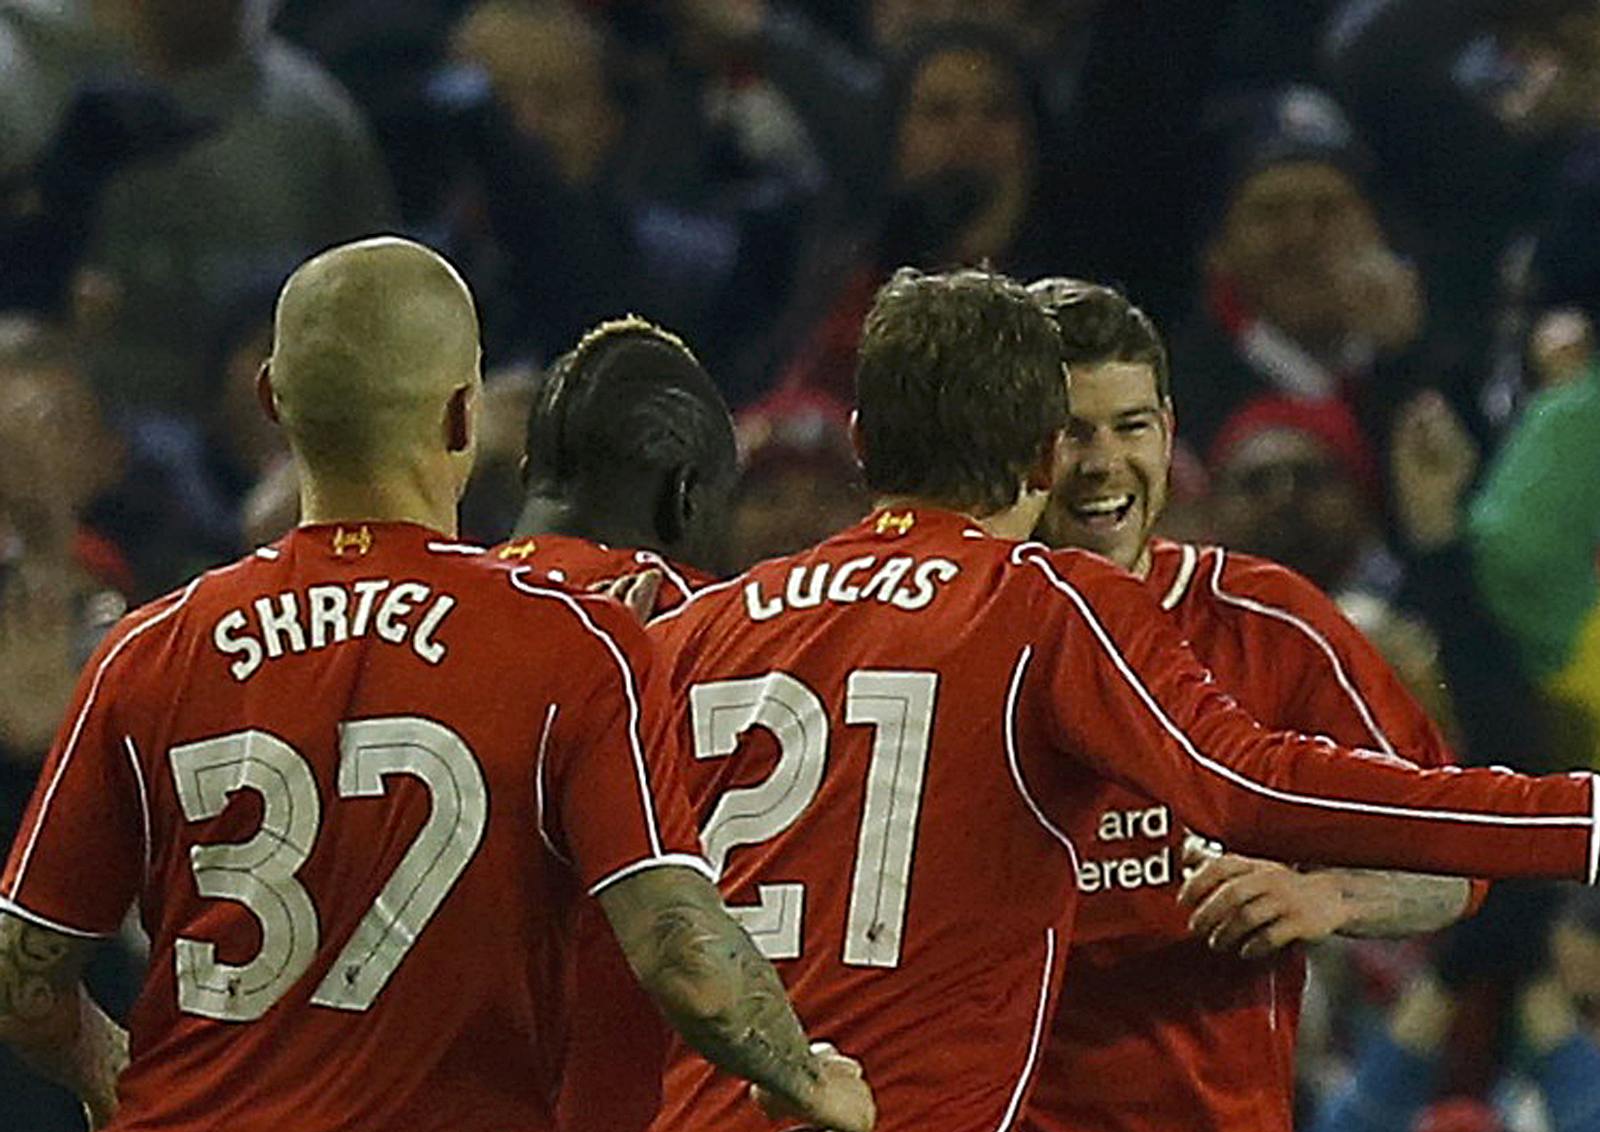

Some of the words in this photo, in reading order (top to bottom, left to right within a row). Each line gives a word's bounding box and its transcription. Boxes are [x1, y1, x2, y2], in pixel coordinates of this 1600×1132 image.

[213, 577, 456, 682] SKRTEL
[744, 555, 958, 622] LUCAS
[168, 715, 489, 1021] 37
[689, 670, 938, 969] 21
